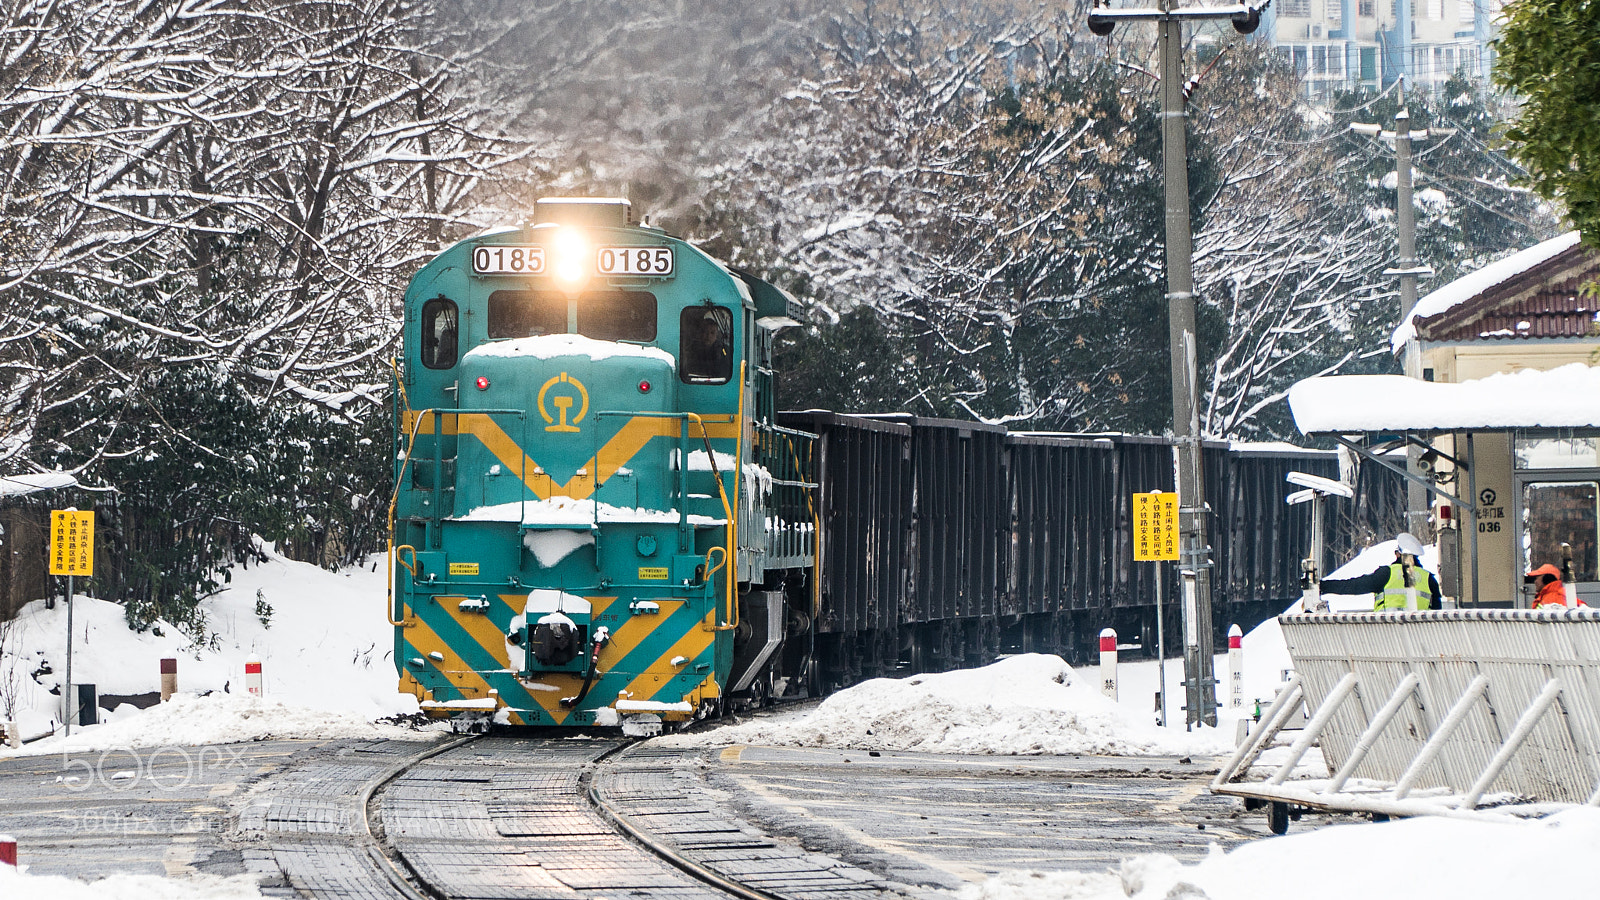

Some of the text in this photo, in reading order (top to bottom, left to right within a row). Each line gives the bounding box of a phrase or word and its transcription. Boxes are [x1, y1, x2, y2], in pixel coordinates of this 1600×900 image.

[475, 248, 543, 272] 0185
[599, 249, 670, 273] 0185
[1479, 521, 1501, 533] 036
